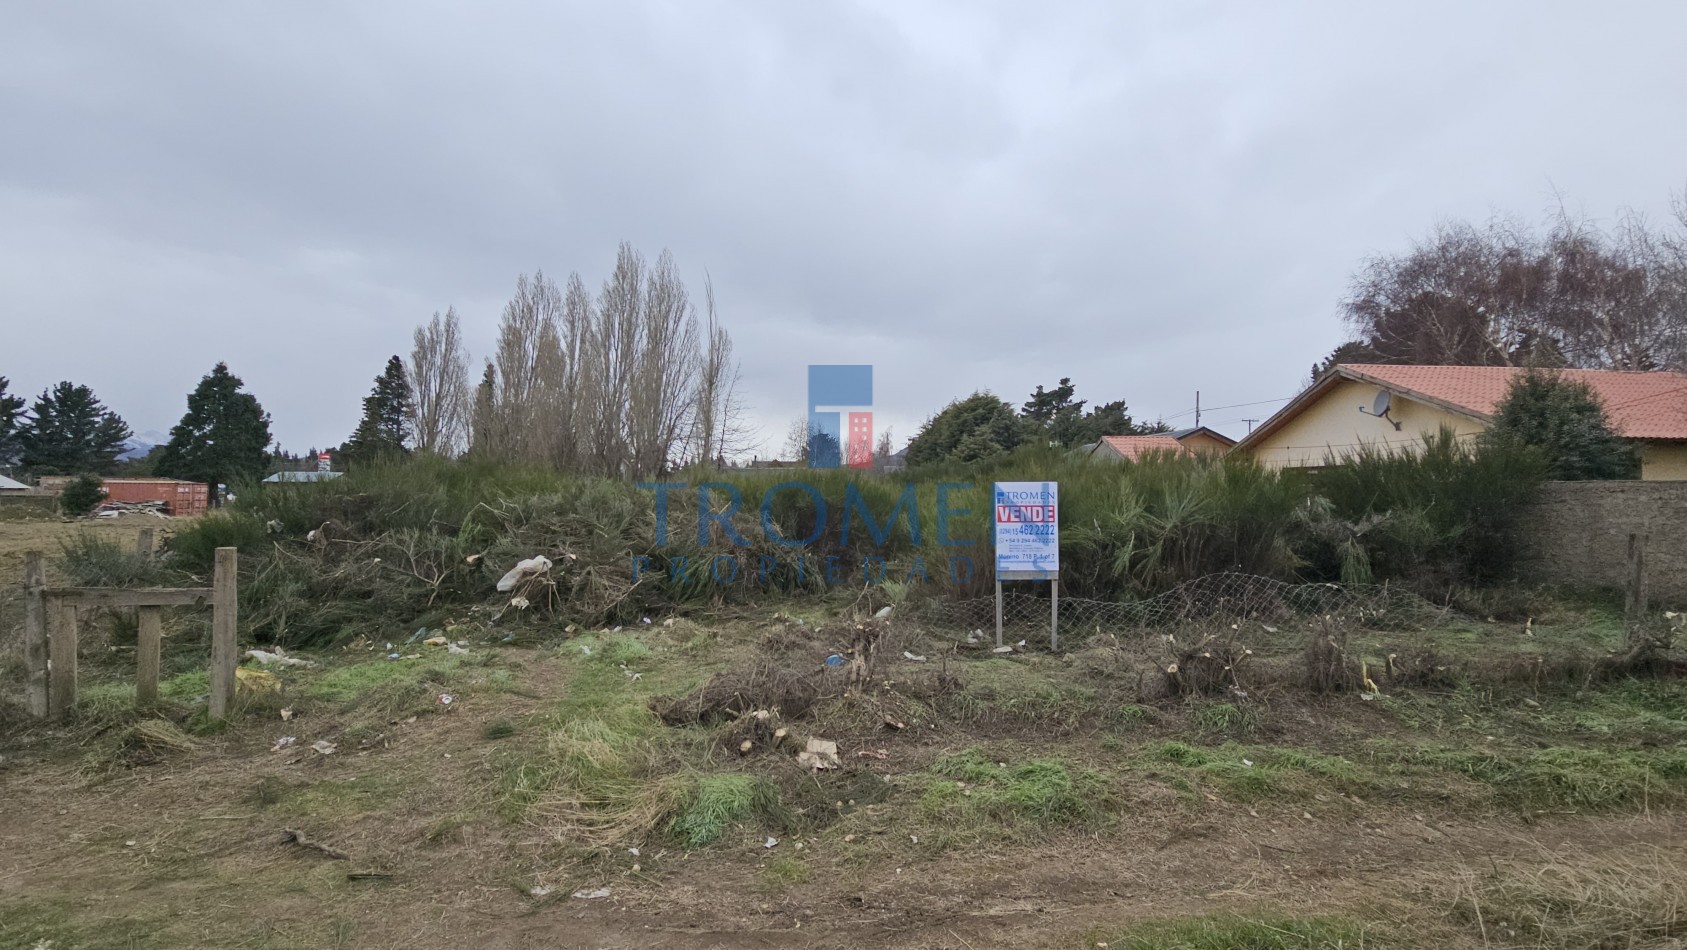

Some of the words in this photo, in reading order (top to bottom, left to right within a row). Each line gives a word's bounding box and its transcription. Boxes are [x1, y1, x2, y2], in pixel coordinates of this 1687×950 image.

[1006, 491, 1055, 500] TROMEN
[998, 506, 1054, 522] VENDE
[1012, 528, 1018, 536] 15
[1019, 525, 1033, 536] 462
[1035, 525, 1055, 536] 2222
